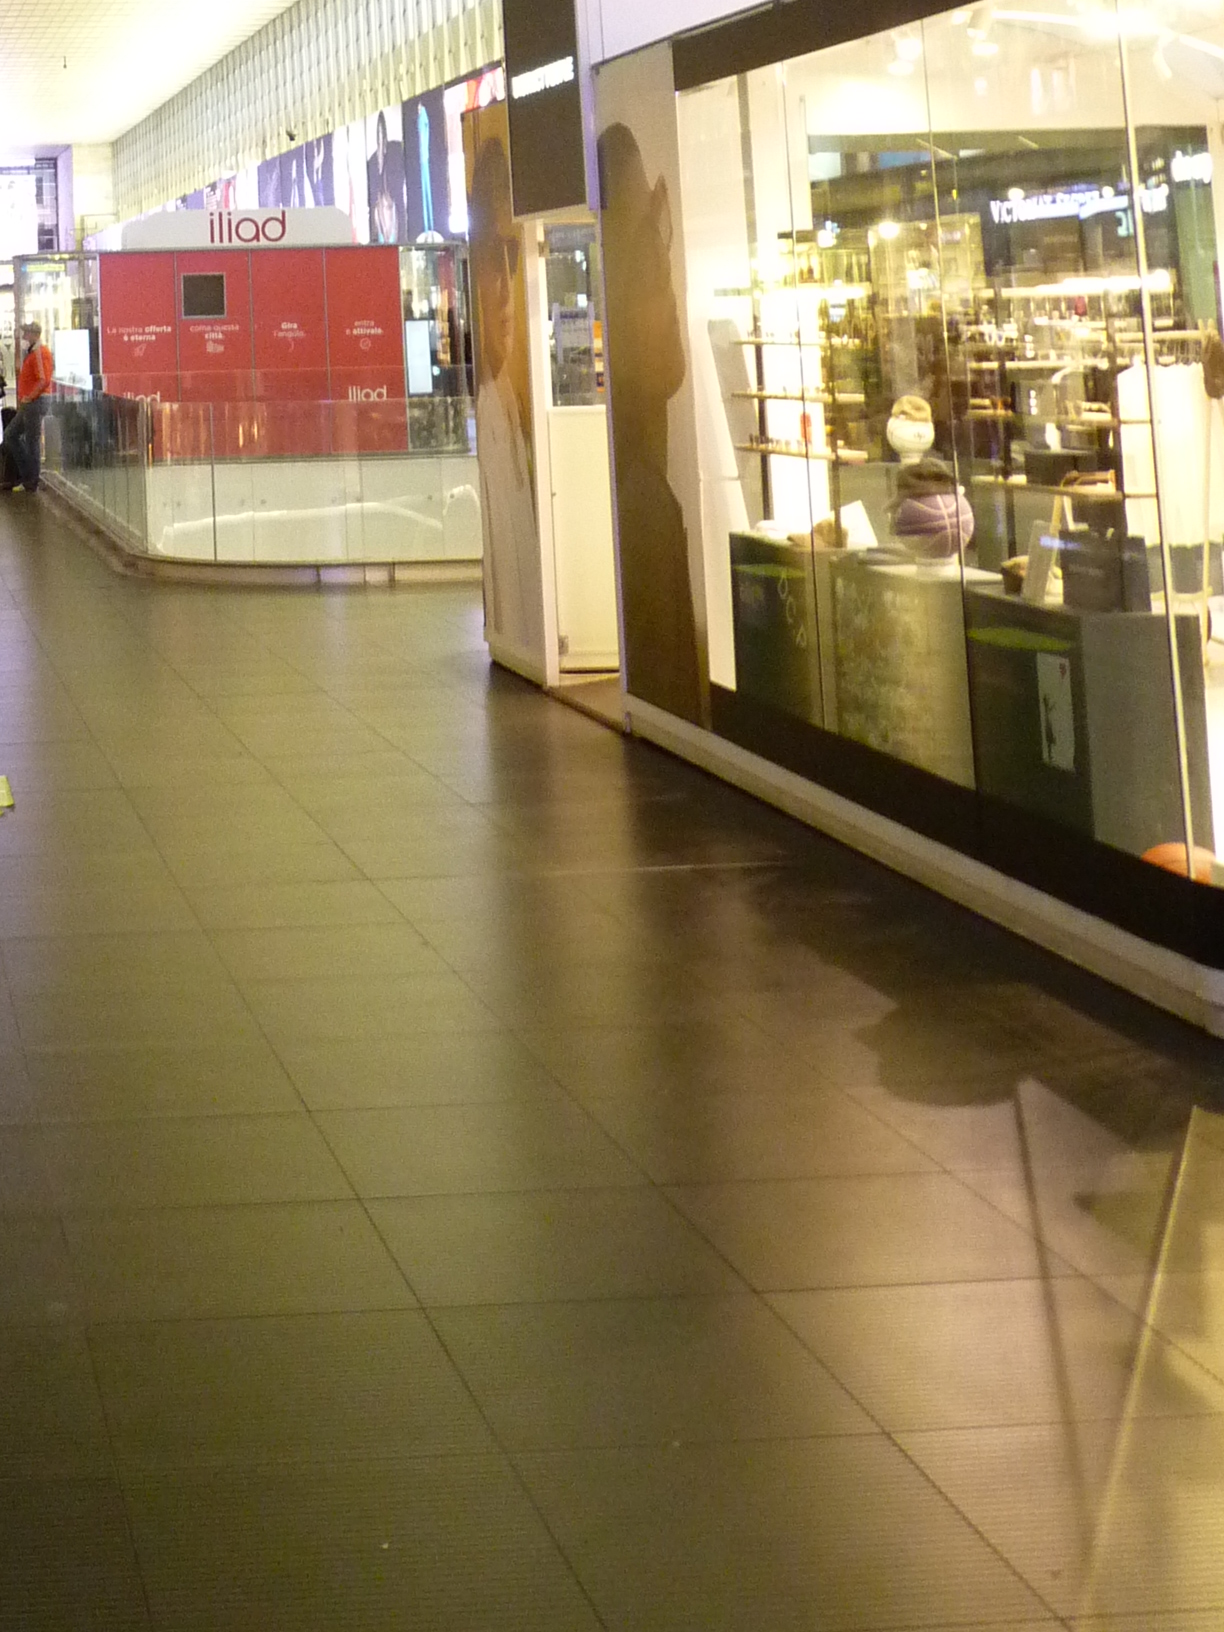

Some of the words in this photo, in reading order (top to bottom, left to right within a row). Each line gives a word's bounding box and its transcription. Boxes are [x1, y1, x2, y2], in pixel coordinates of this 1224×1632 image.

[209, 209, 287, 244] iliad
[106, 325, 117, 334] La
[118, 325, 143, 334] nostra
[144, 324, 172, 334] offerta
[281, 321, 298, 329] Gira
[130, 333, 156, 342] eterna
